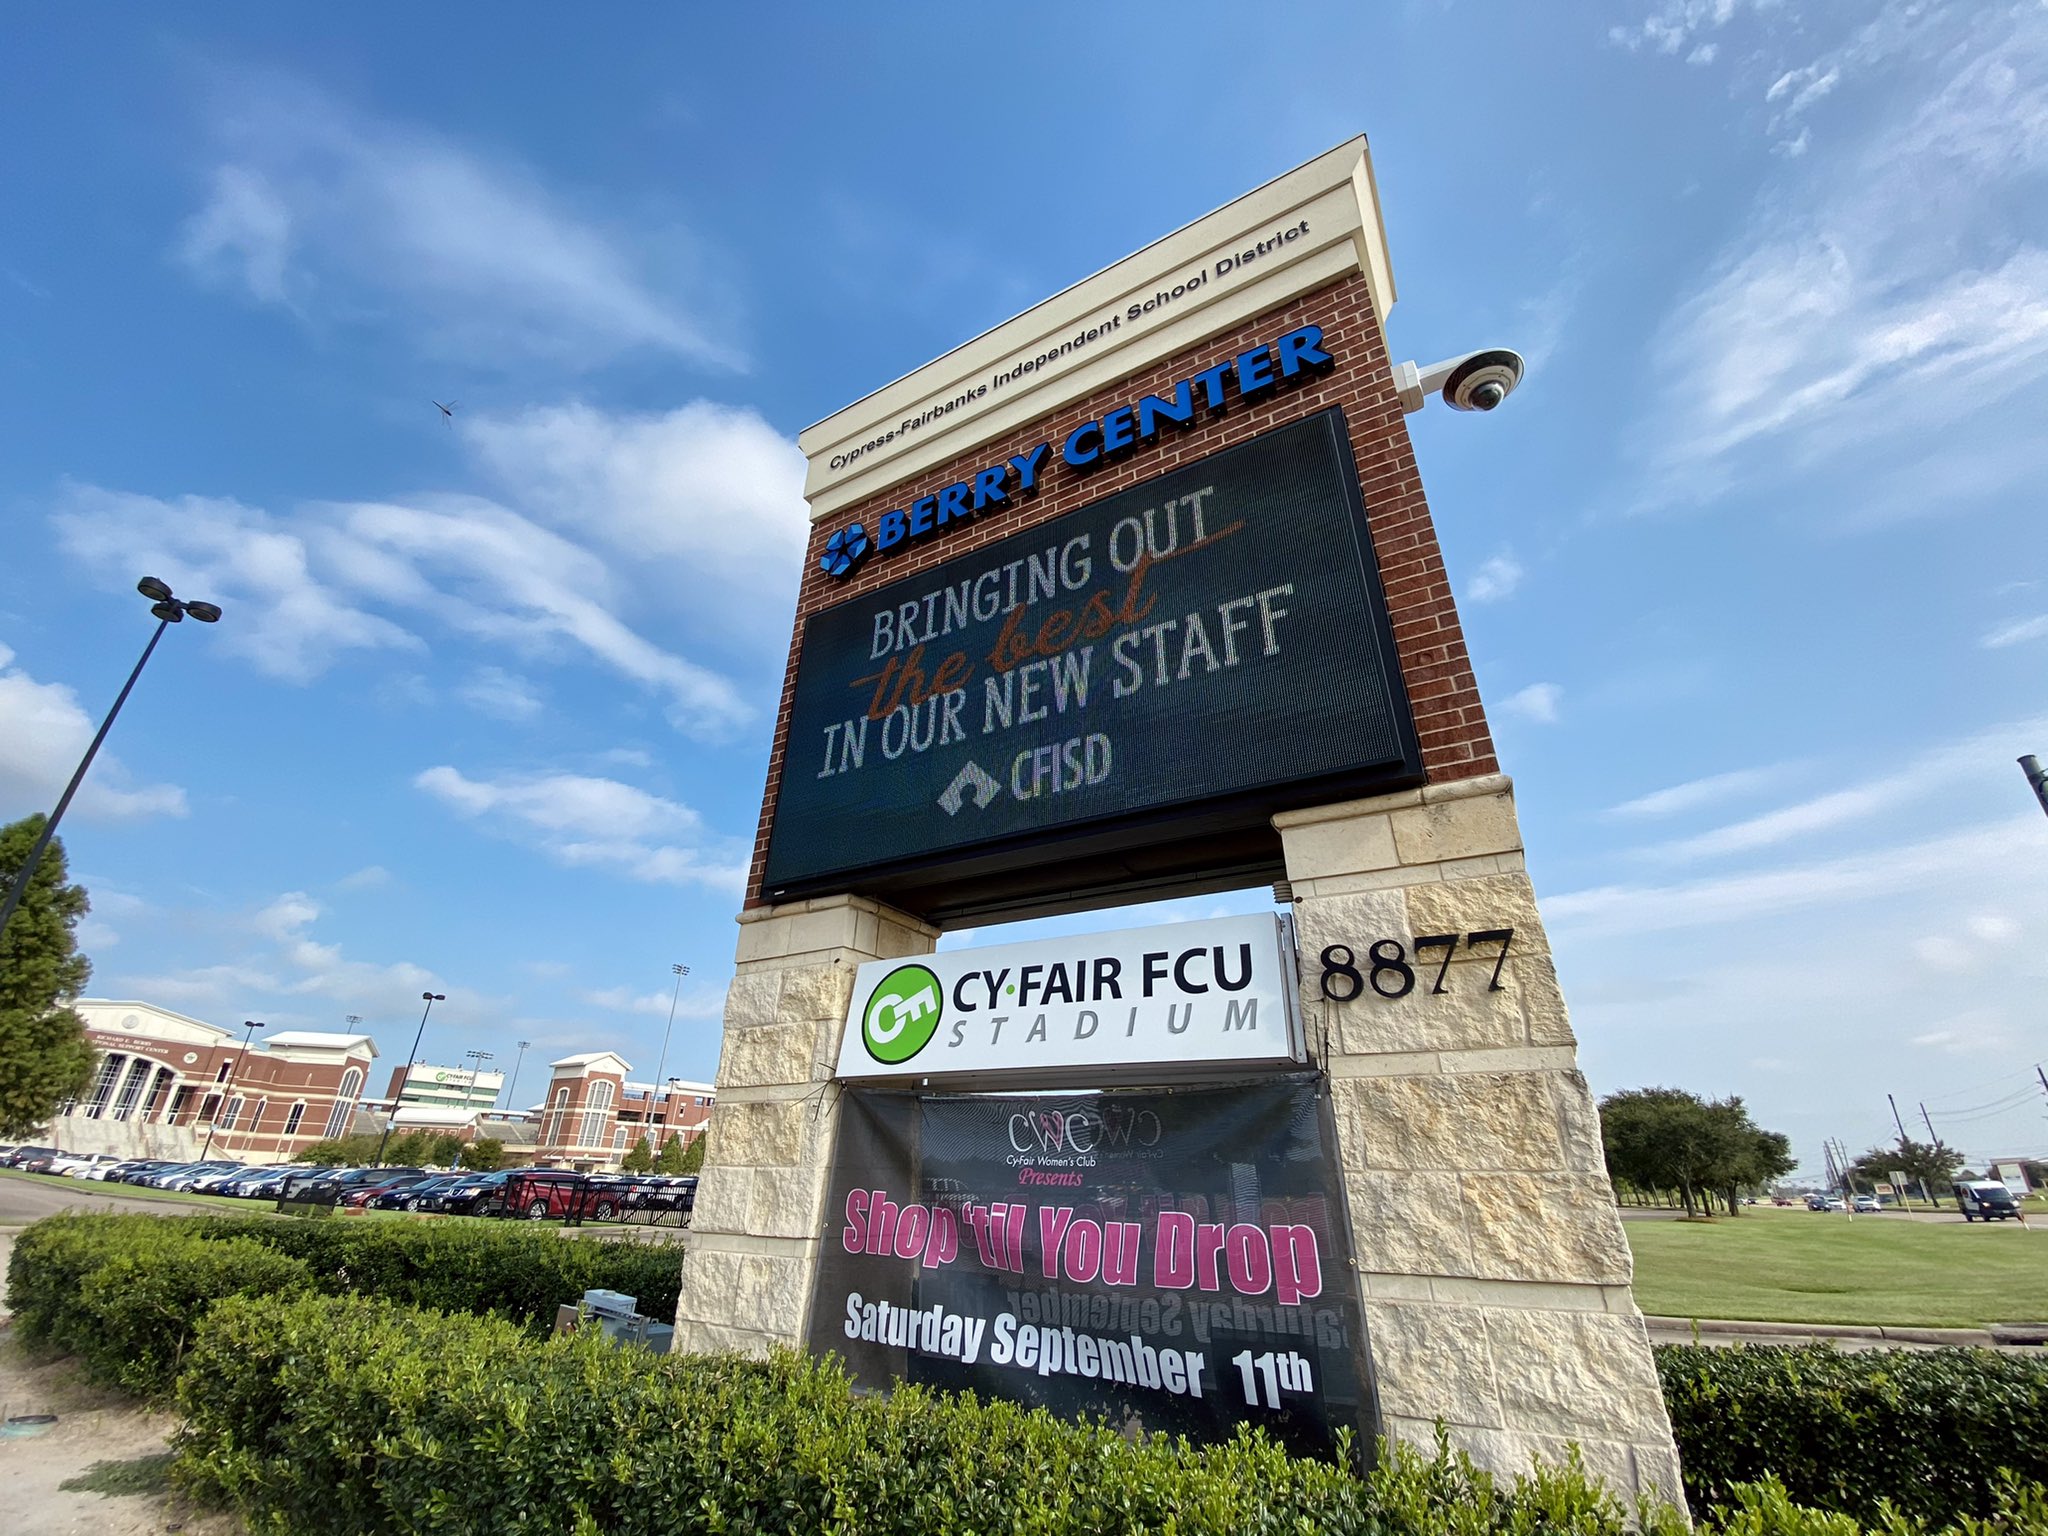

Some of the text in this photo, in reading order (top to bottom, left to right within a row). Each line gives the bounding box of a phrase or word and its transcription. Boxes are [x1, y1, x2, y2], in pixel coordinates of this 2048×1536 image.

[829, 220, 1310, 470] Cypress-Fairbanks Independent School District
[877, 324, 1334, 551] BERRY CENTER
[869, 485, 1214, 661] BRINGING OUT
[816, 583, 1294, 780] IN OUR NEW STAFF
[850, 645, 975, 721] the
[1011, 732, 1112, 801] CFISD
[1142, 943, 1253, 999] FCU
[1320, 928, 1514, 1002] 8877
[948, 998, 1258, 1048] STADIUM
[1006, 1155, 1097, 1168] Cy-Fair Women's Club
[1008, 1110, 1094, 1153] CWC
[1018, 1167, 1084, 1187] Presents
[842, 1188, 1323, 1306] Shop 'til You Drop
[844, 1292, 1314, 1410] Saturday September 11th
